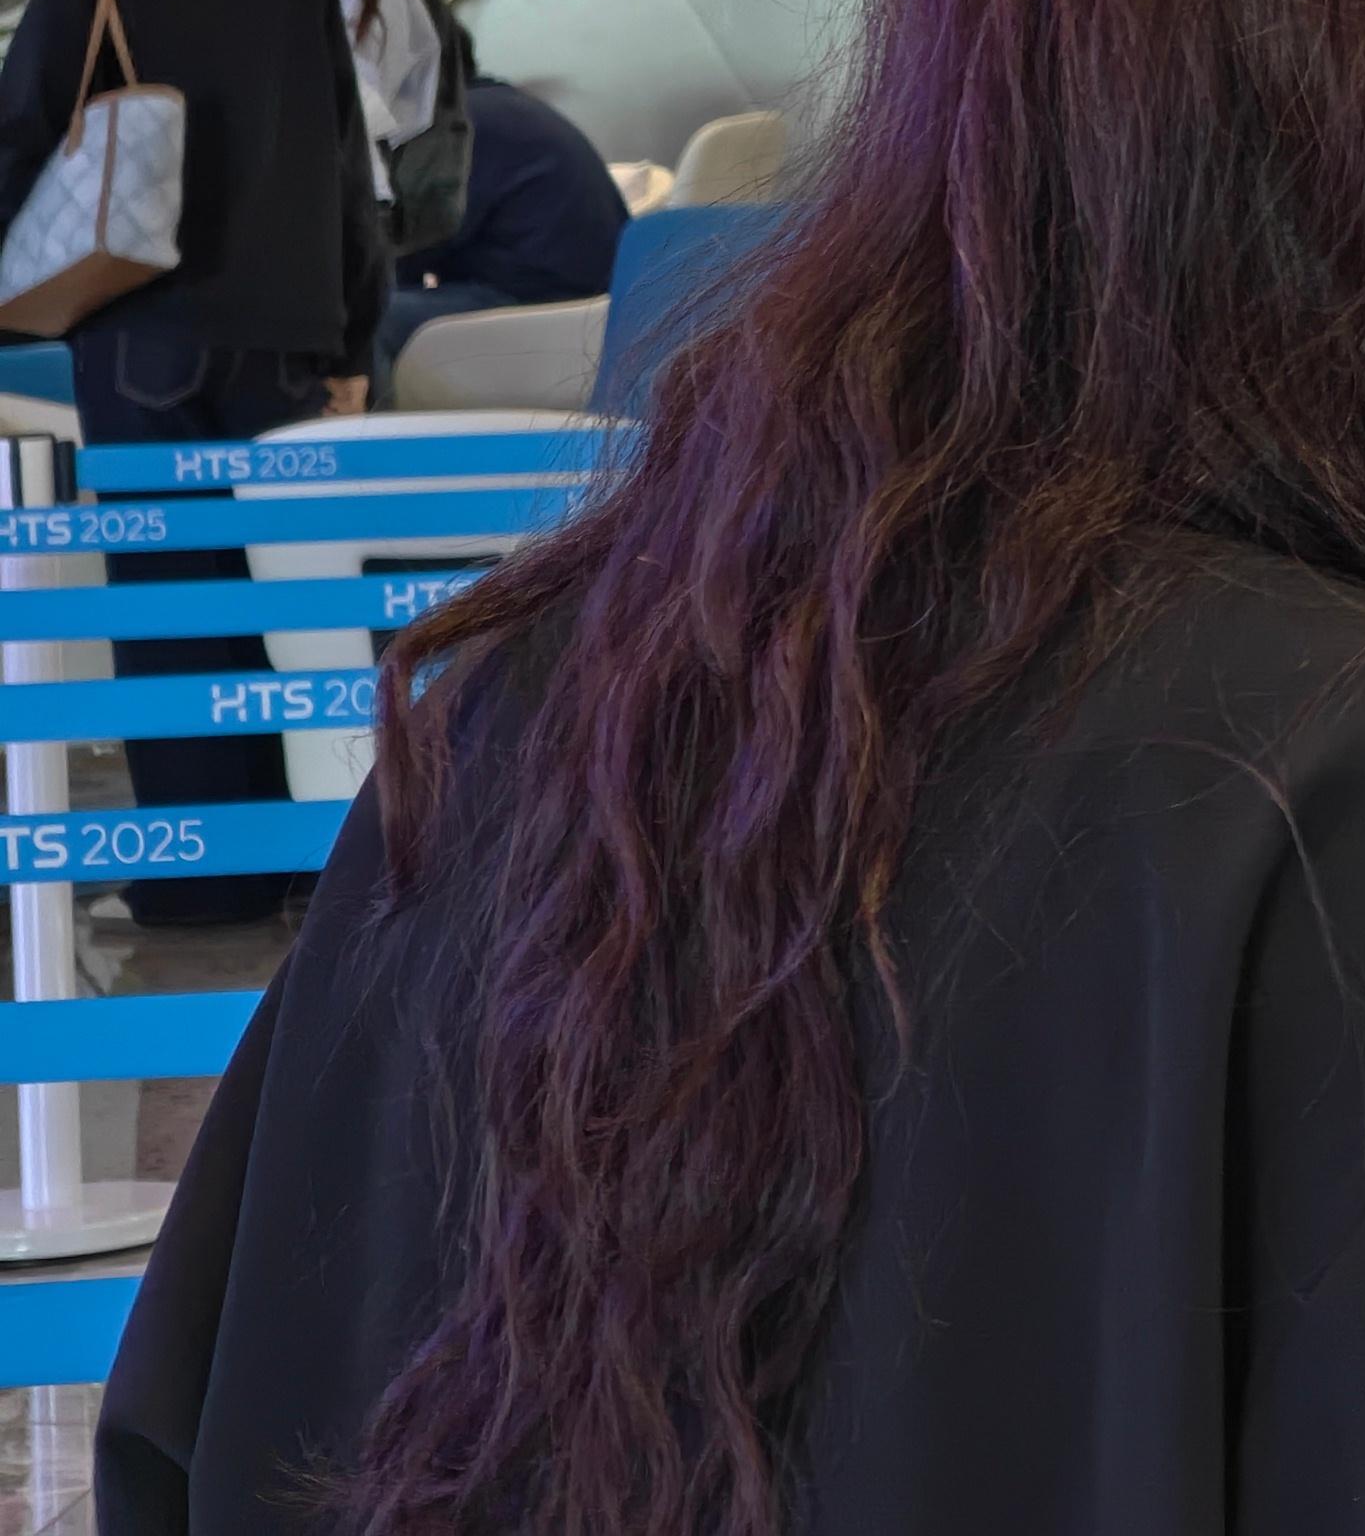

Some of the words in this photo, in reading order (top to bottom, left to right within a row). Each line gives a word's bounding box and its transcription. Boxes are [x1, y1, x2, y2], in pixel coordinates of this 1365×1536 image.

[175, 447, 251, 482] HTS
[258, 445, 337, 479] 2025
[79, 508, 167, 544] 2025
[211, 679, 314, 724] HTS
[81, 818, 205, 866] 2025
